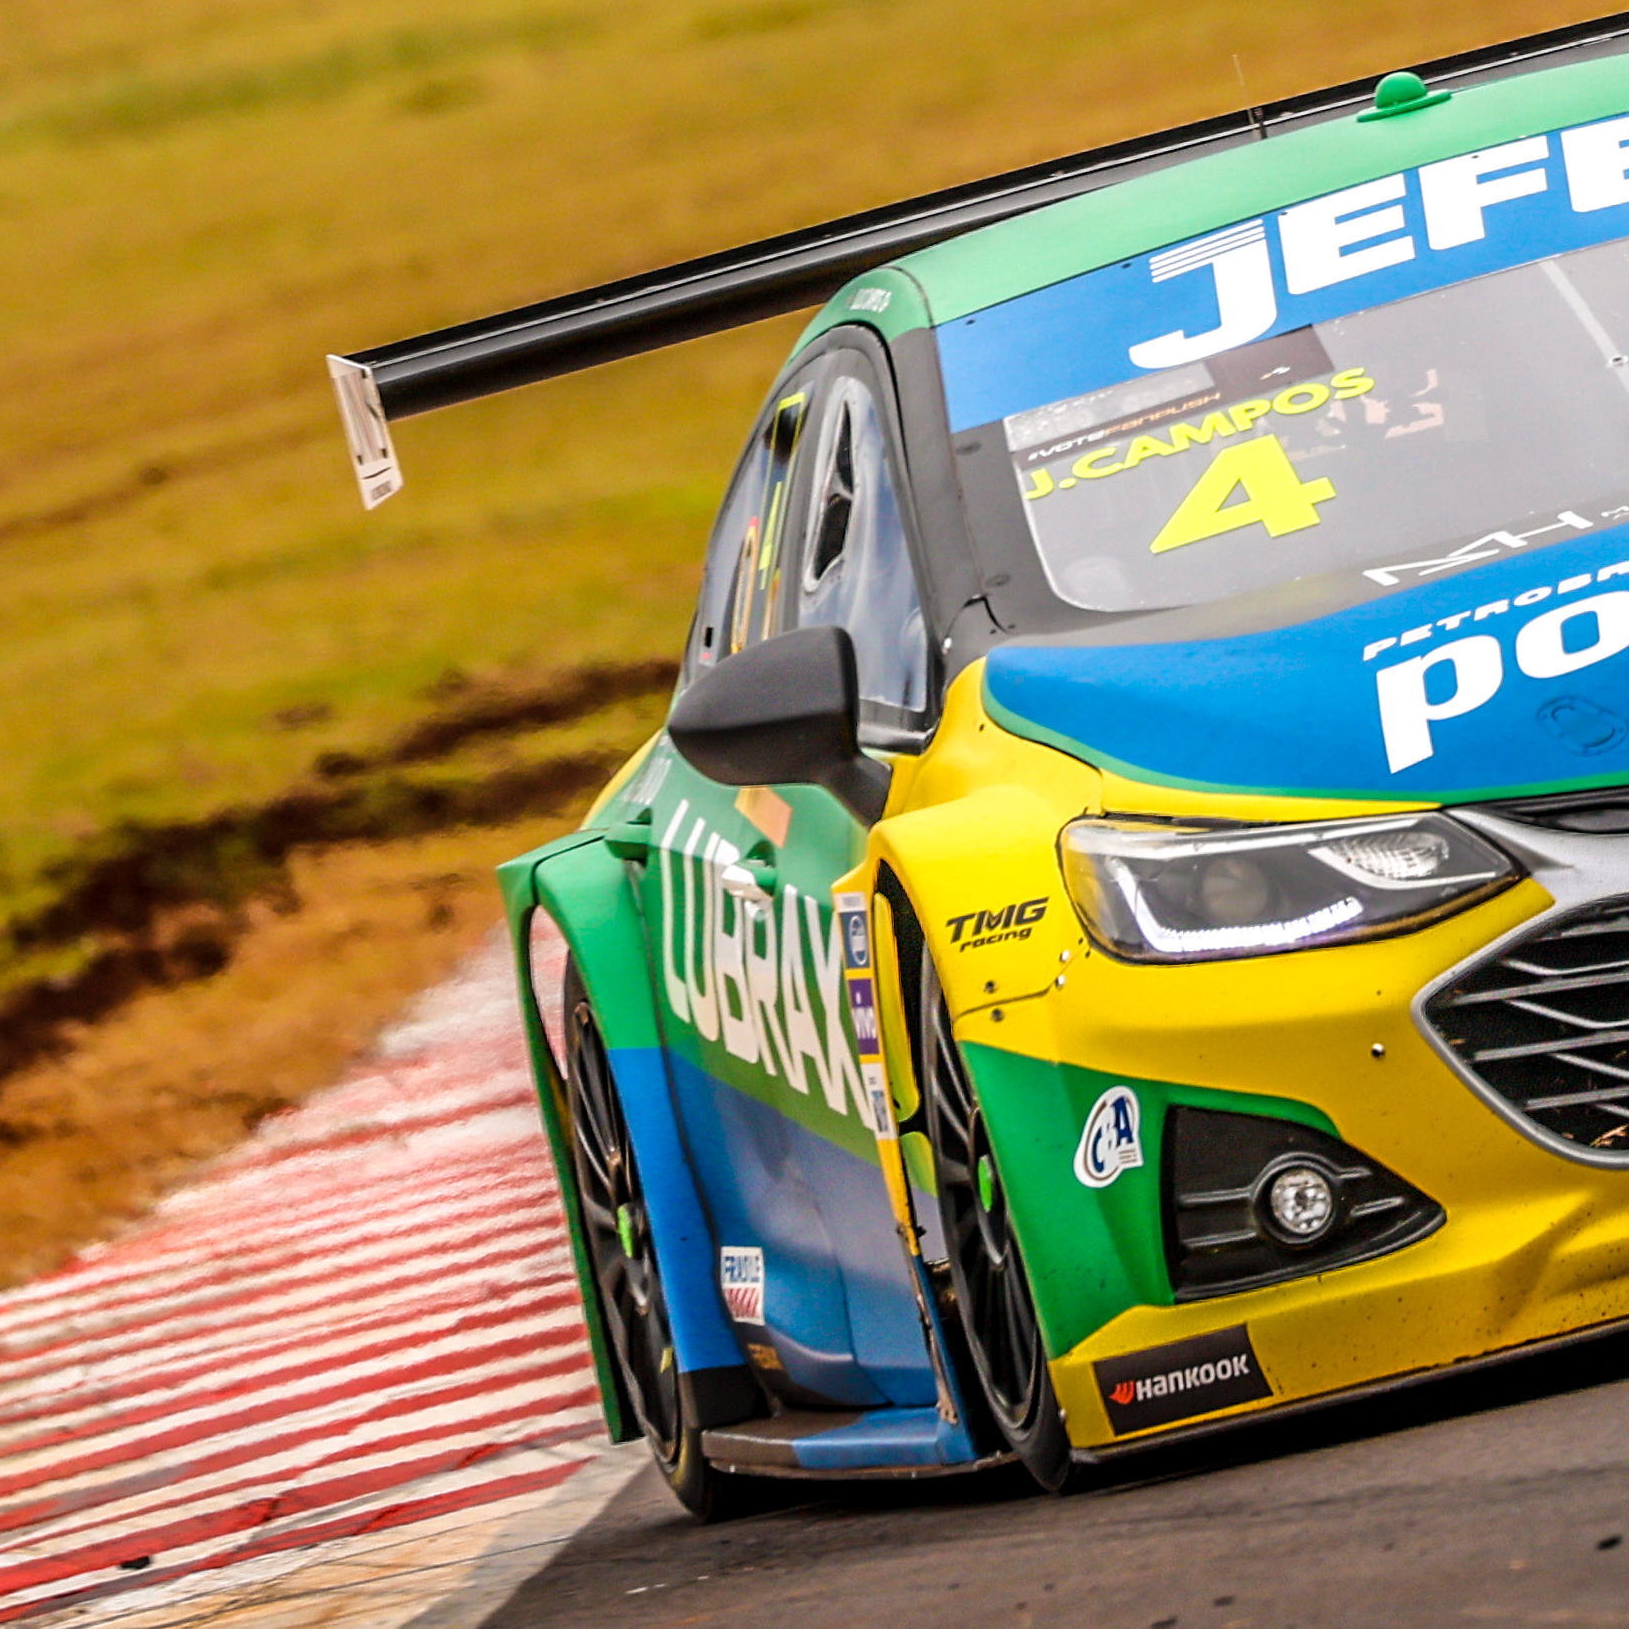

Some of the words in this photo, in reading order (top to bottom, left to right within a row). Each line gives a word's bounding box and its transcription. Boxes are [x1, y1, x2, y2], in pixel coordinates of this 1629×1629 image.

[1022, 367, 1375, 501] J.CAMPOS
[1149, 433, 1338, 555] 4
[660, 798, 877, 1132] LUBRAX
[945, 896, 1050, 945] TMG
[958, 926, 1033, 953] racing
